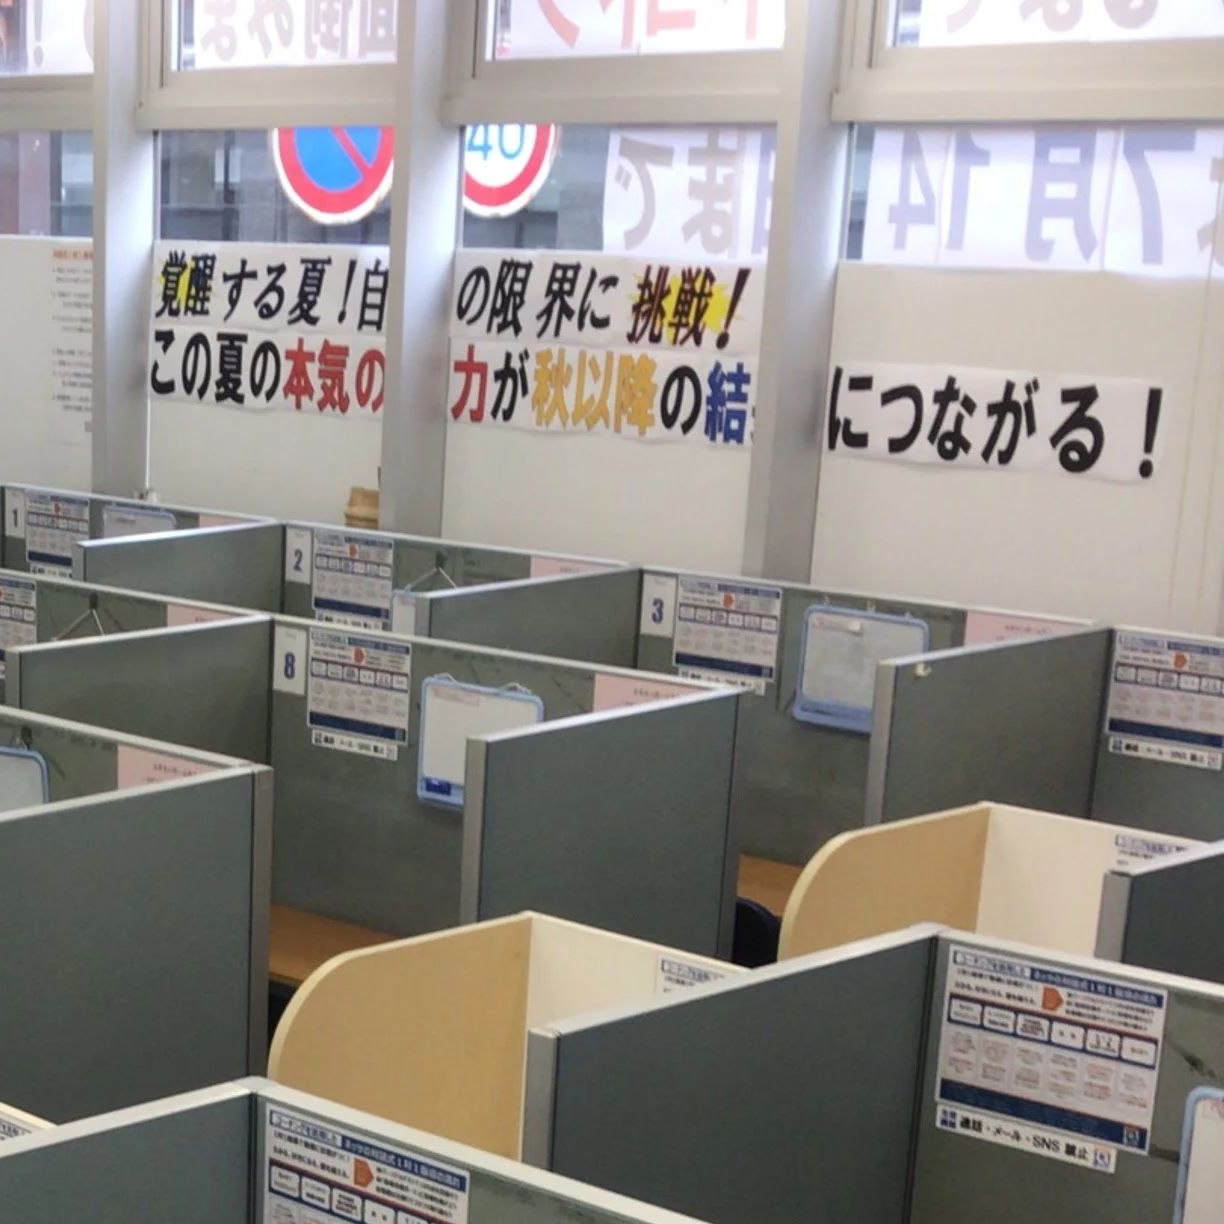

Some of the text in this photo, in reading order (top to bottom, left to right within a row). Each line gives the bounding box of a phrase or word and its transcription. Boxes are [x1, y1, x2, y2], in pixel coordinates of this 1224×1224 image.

[155, 250, 751, 350] 覚醒する夏！自 の限界に挑戦！
[151, 329, 386, 415] この夏の本気の
[450, 343, 756, 446] 力が秋以降の結
[828, 366, 1163, 480] につながる！
[293, 550, 303, 572] 2
[651, 598, 665, 626] 3
[283, 651, 296, 680] 8
